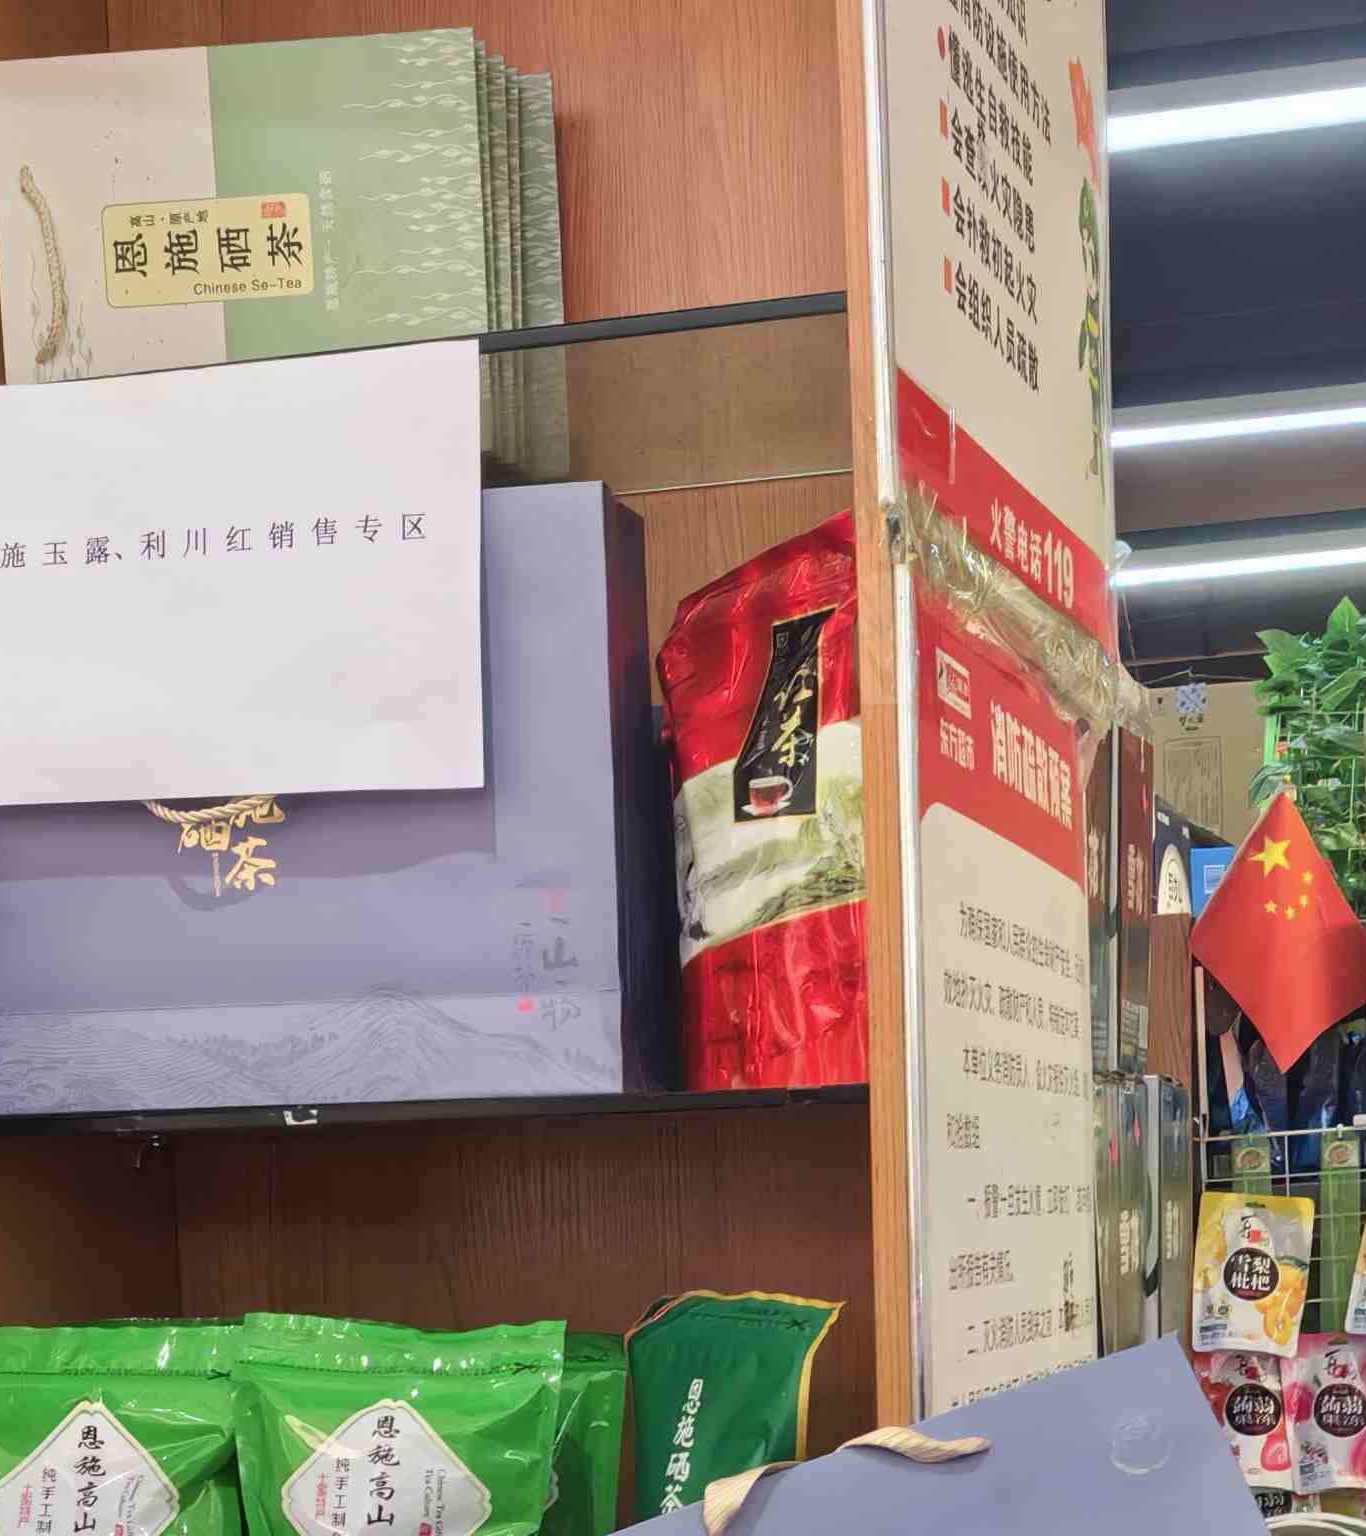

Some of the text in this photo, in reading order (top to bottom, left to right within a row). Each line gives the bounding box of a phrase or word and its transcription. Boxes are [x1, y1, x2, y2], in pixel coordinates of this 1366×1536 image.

[112, 222, 304, 278] 恩施硒茶
[193, 281, 247, 296] Chinese
[954, 261, 1040, 395] 会组织人员疏散
[989, 497, 1075, 611] 火警电话119
